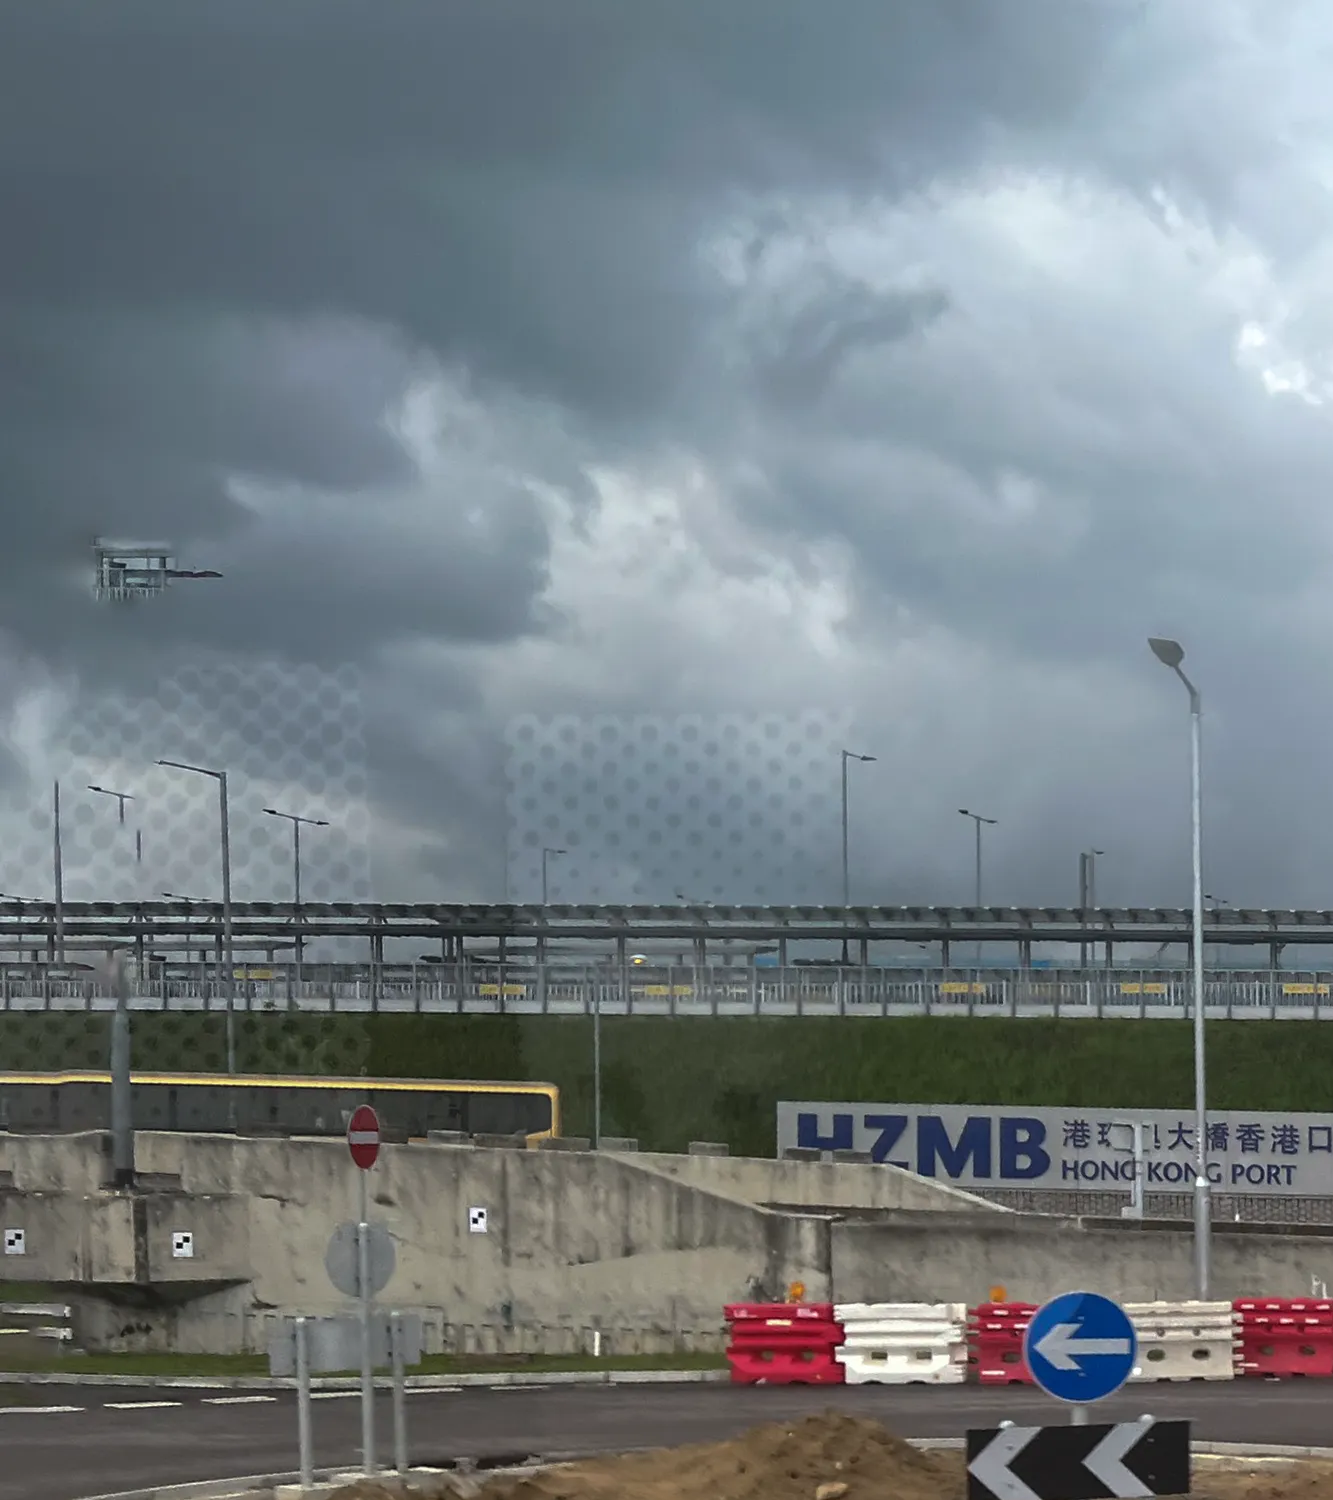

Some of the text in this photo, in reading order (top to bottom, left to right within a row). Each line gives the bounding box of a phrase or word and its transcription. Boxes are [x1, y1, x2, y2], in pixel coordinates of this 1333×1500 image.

[797, 1113, 1052, 1179] HZMB
[1060, 1159, 1297, 1185] HONG KONG PORT
